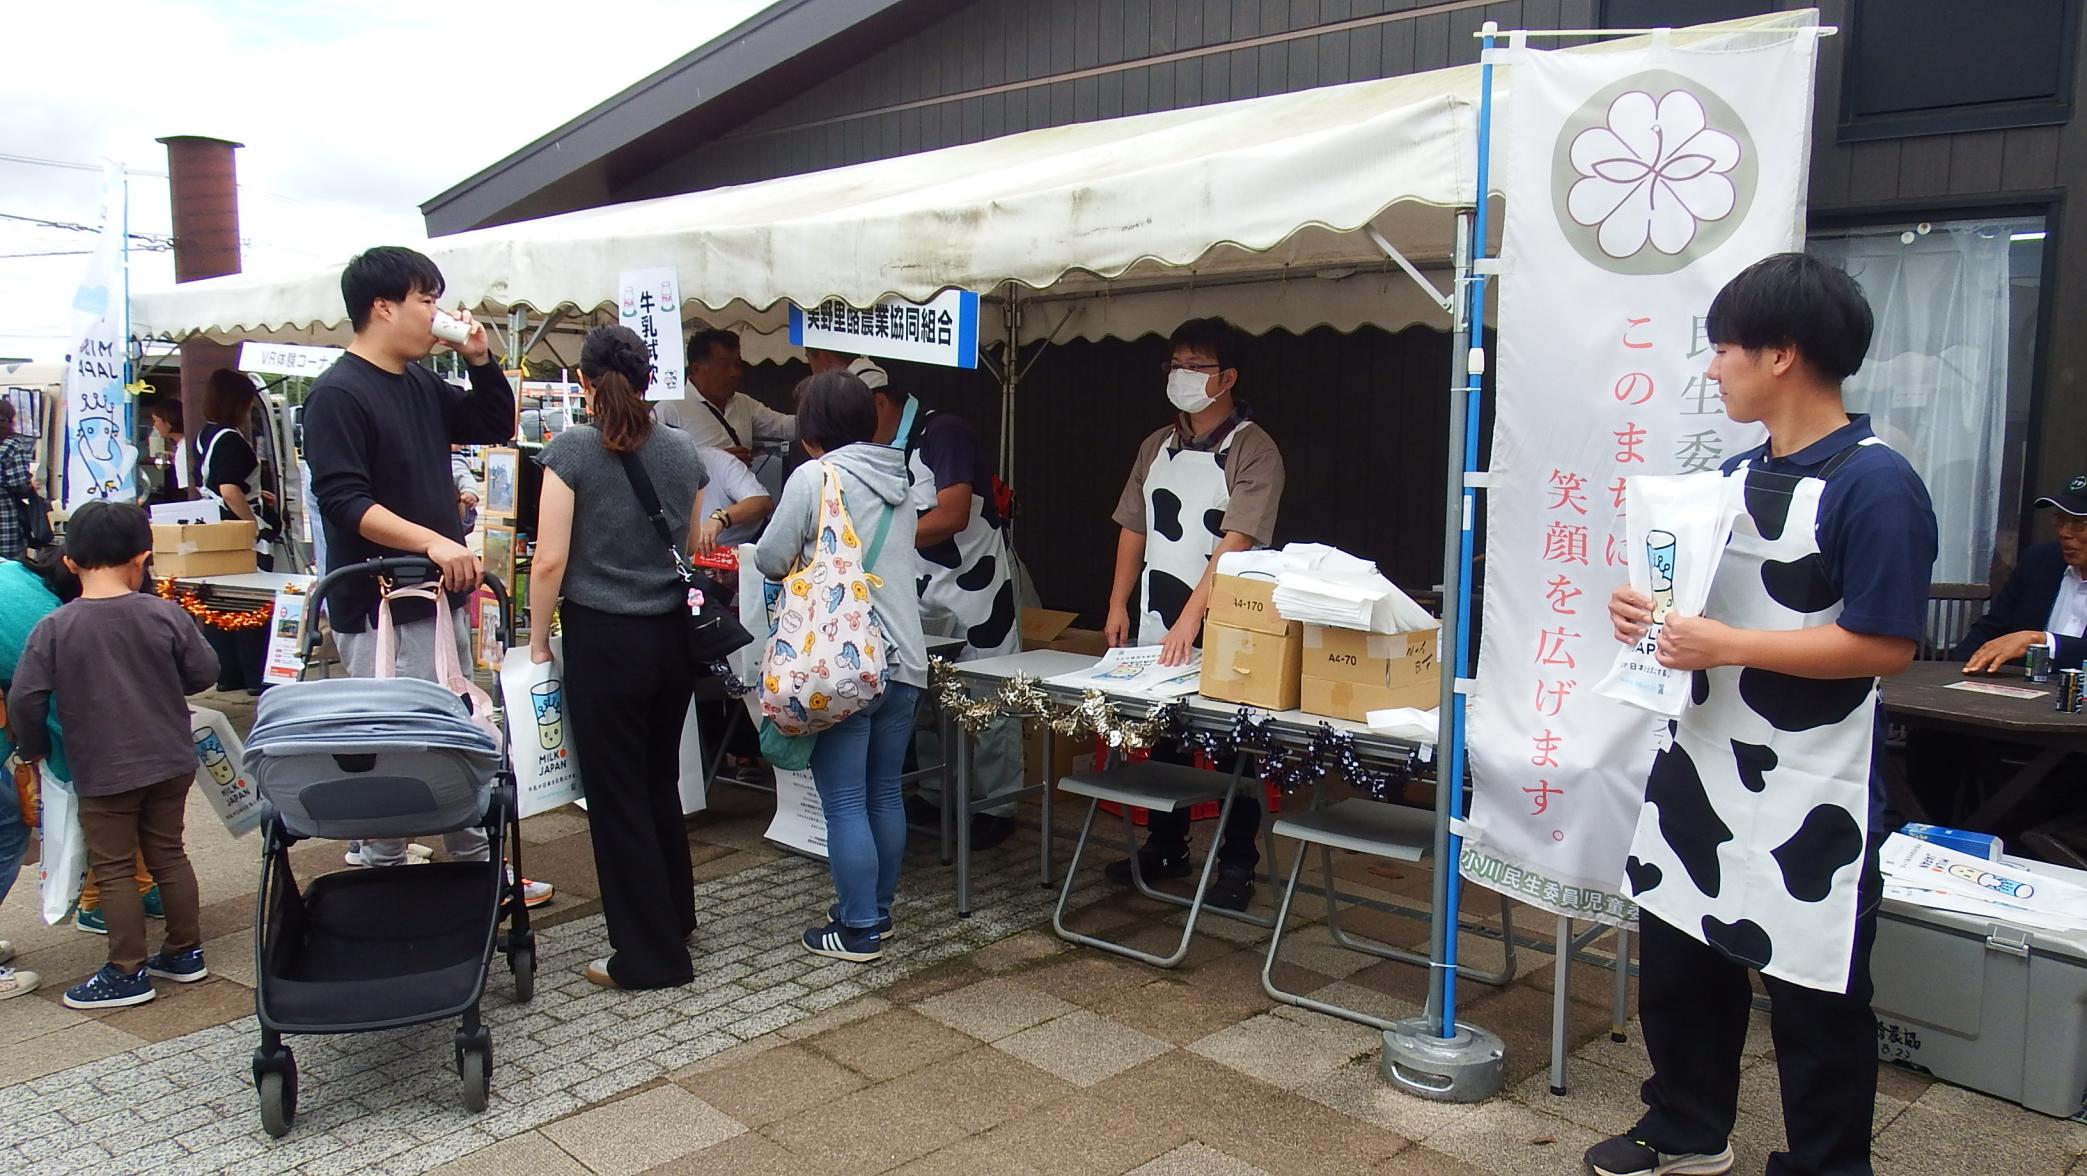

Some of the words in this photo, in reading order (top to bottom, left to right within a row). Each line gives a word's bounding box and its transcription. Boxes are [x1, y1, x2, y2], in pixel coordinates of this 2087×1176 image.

[262, 350, 334, 371] VR体験コーナ
[1521, 468, 1589, 842] 笑顔を広げます。
[539, 750, 561, 764] MILK
[538, 760, 567, 776] JAPAN
